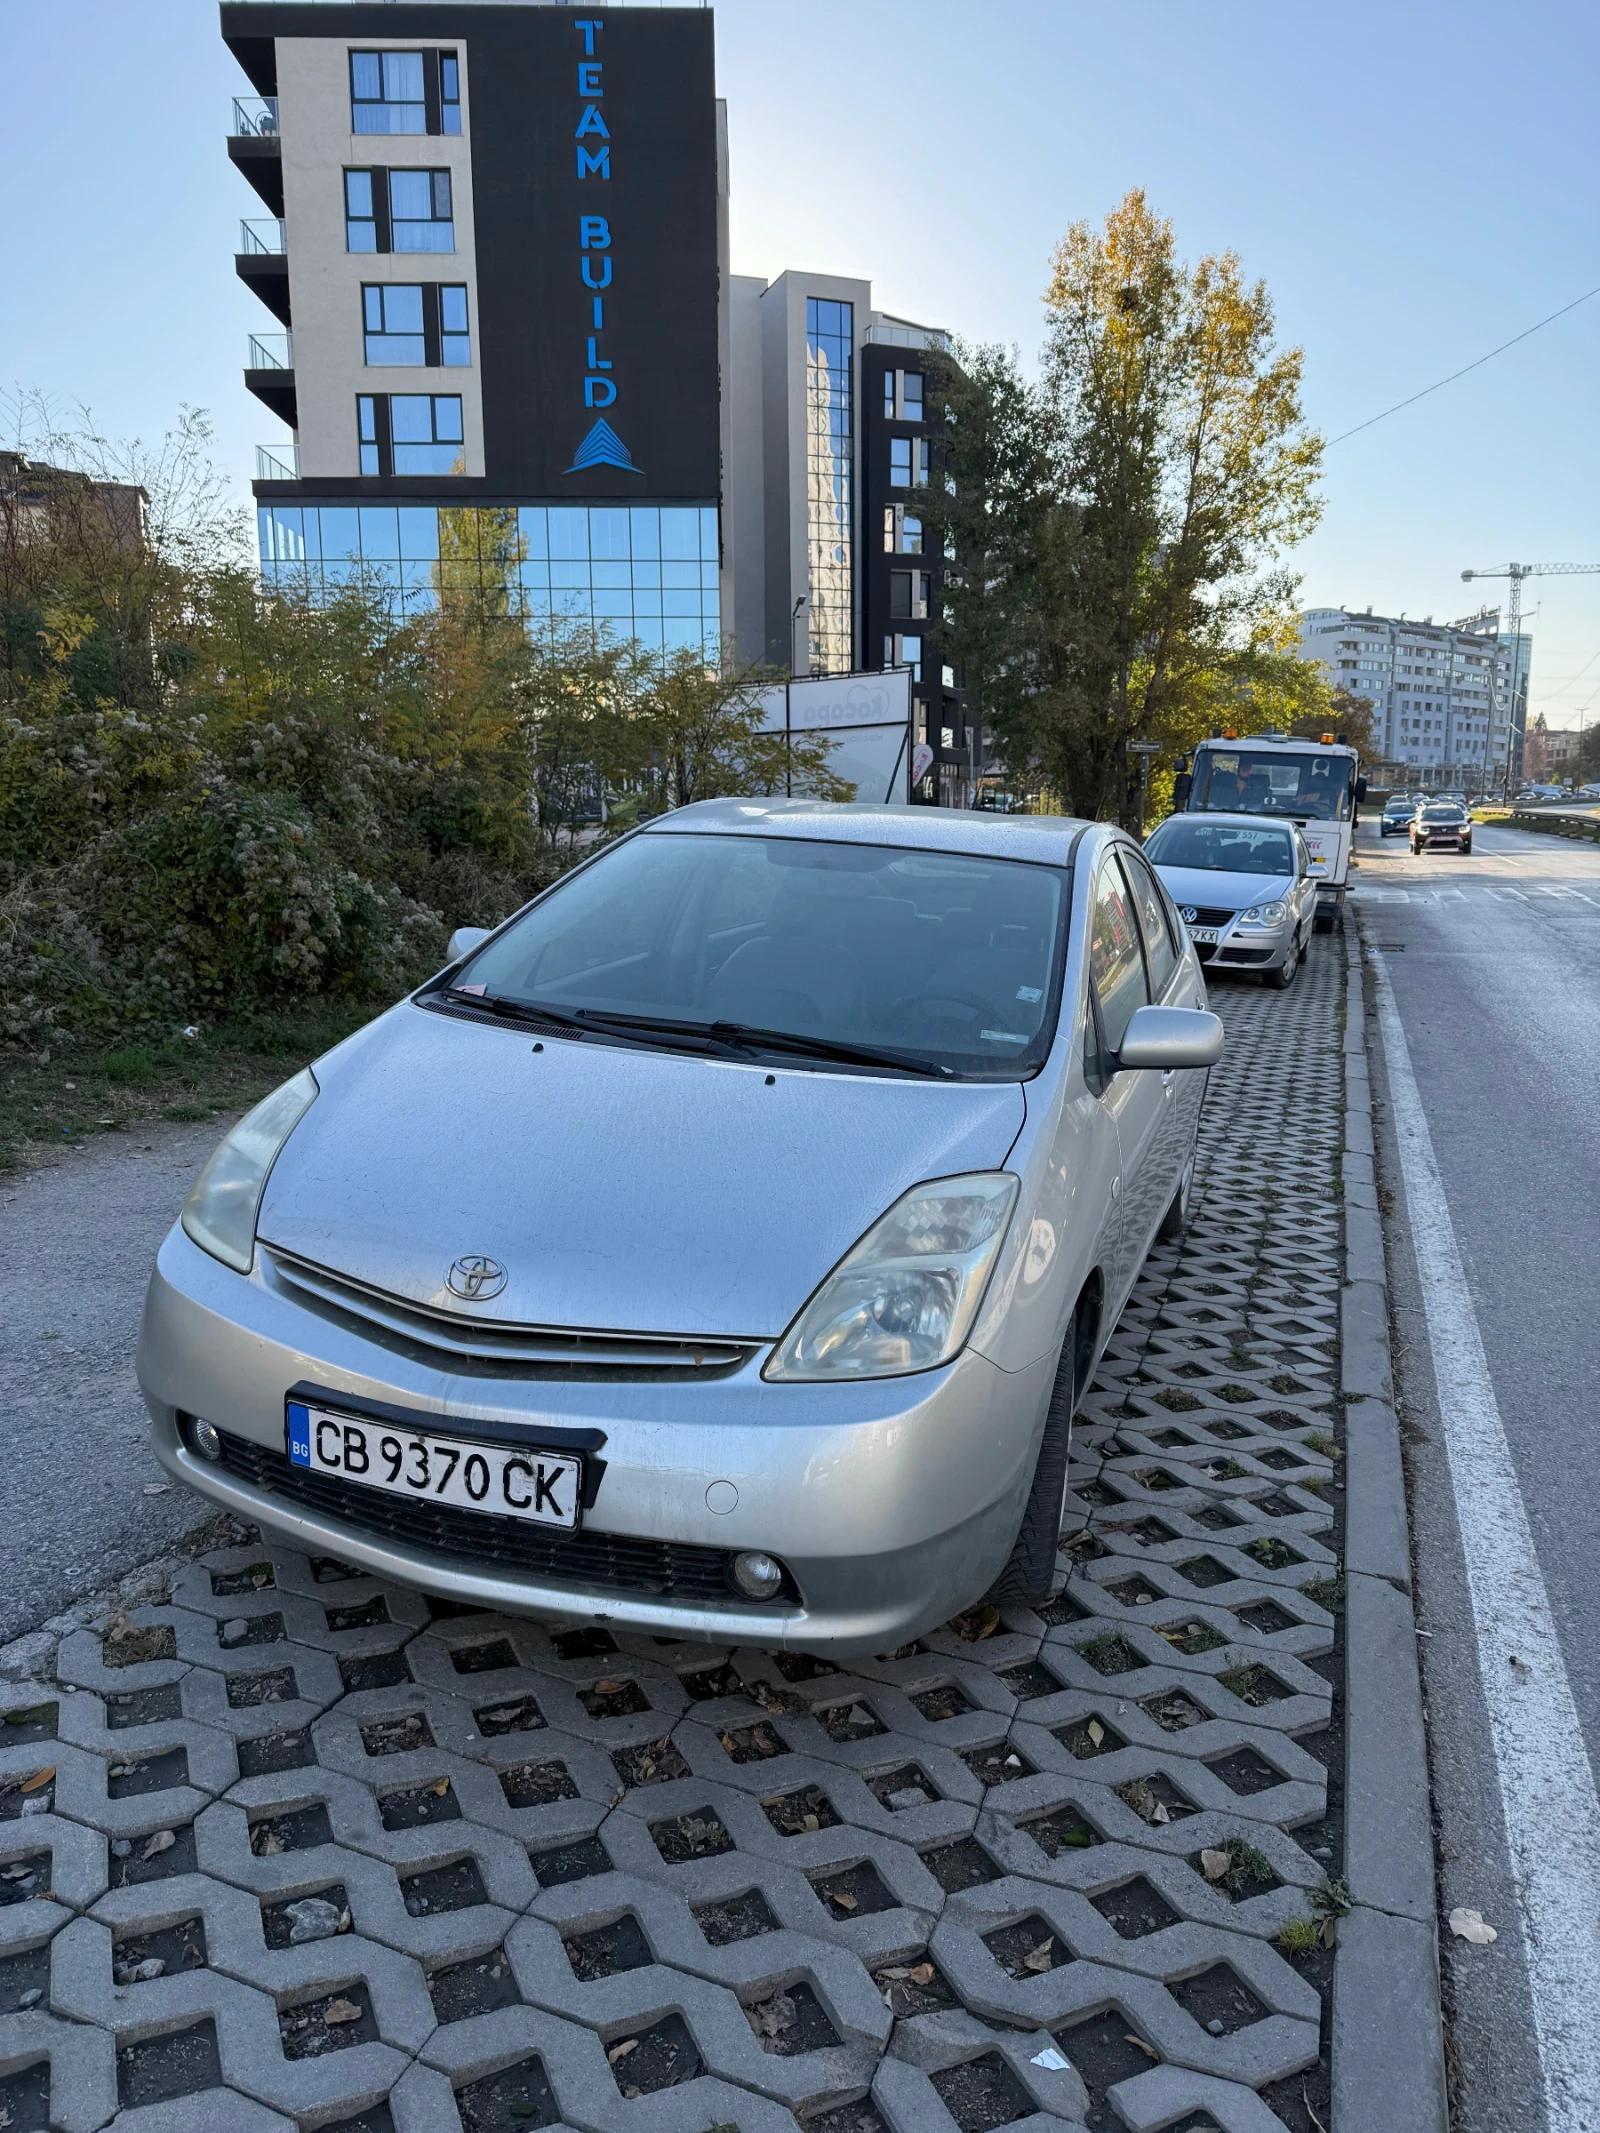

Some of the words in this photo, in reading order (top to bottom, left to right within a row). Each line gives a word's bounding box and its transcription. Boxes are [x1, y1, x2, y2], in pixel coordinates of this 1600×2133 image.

[574, 20, 611, 180] TEAM
[580, 215, 618, 408] BUILD
[293, 1441, 308, 1457] BG
[316, 1419, 370, 1474] CB
[380, 1436, 490, 1501] 9370
[503, 1457, 565, 1517] CK
